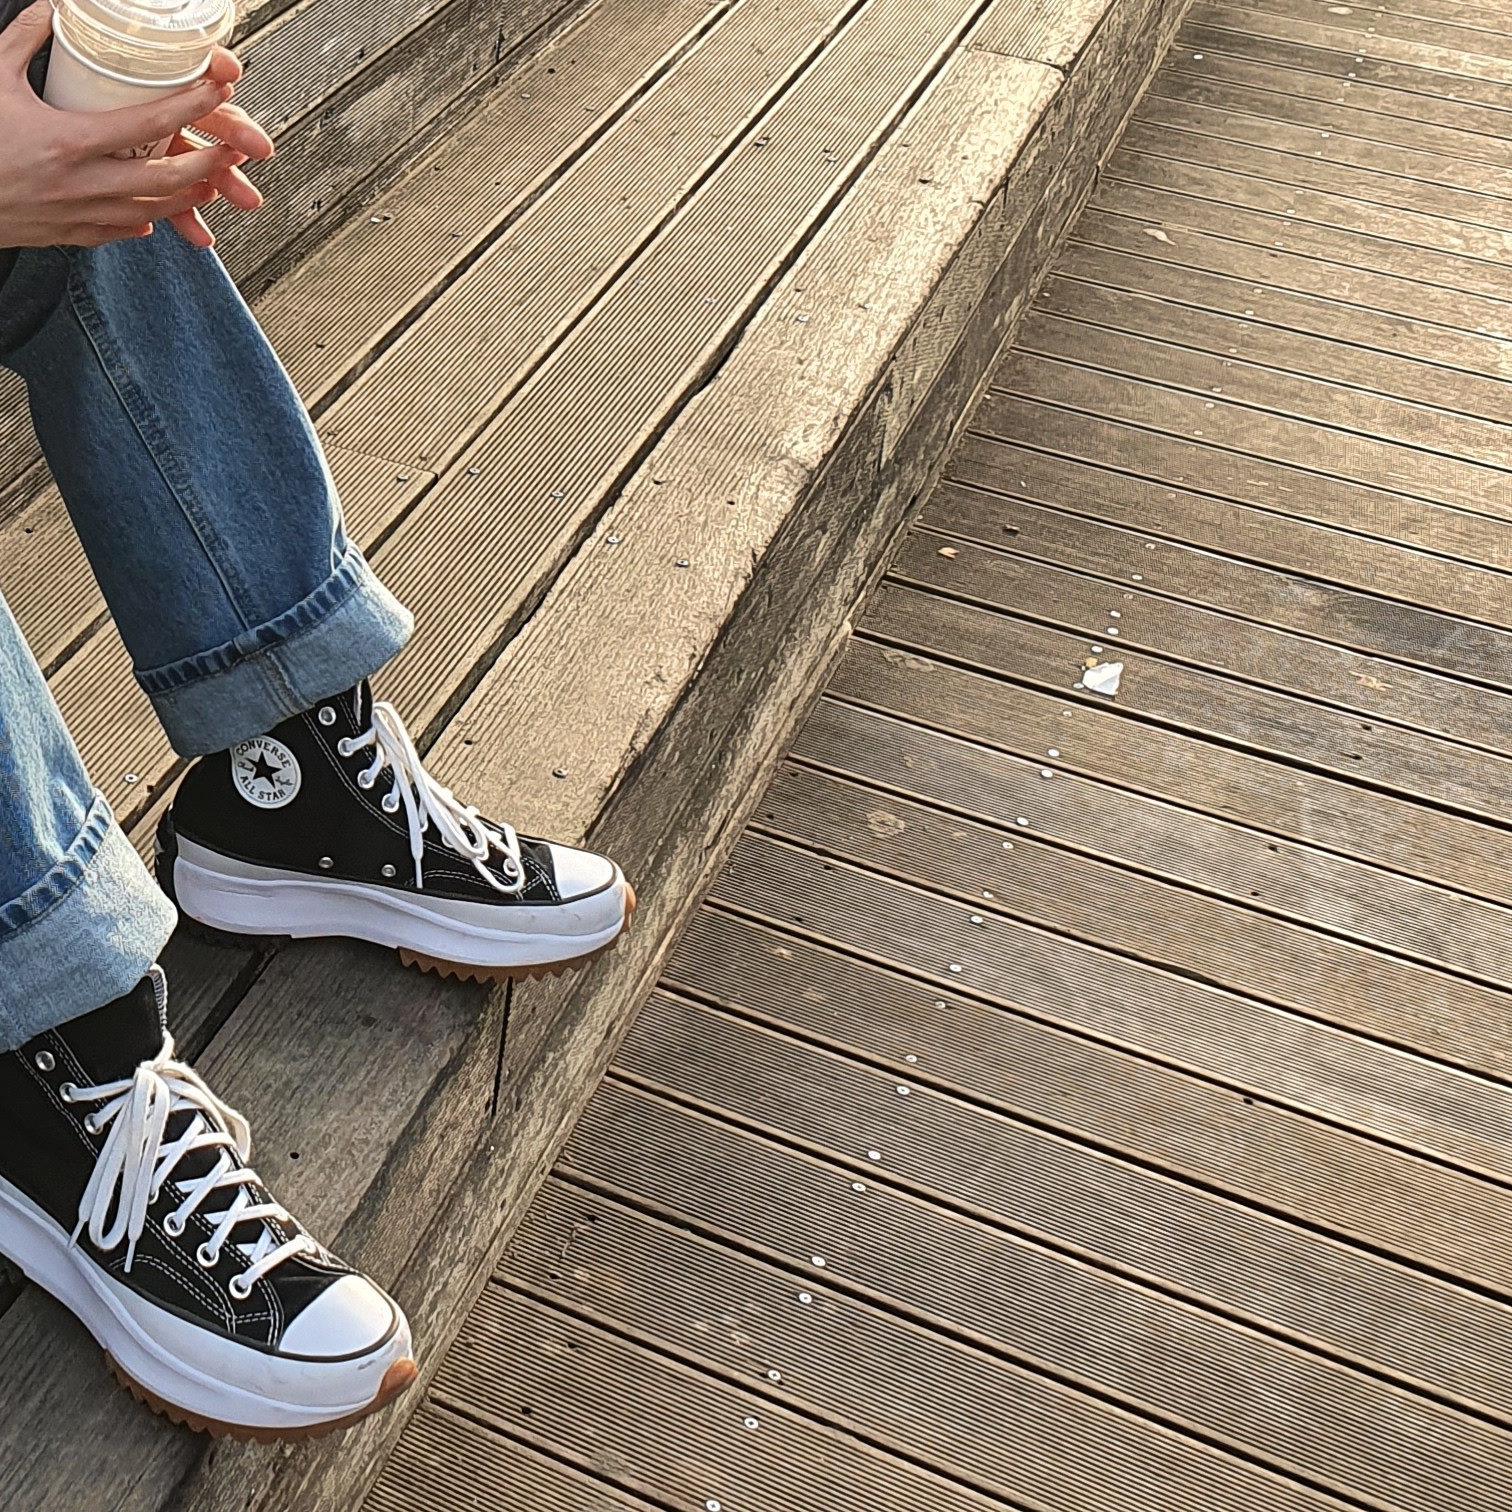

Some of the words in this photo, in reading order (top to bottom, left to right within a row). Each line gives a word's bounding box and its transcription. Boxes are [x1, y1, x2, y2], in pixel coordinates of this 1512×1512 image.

[235, 739, 291, 768] CONVERSE
[240, 774, 256, 795] ALL
[257, 788, 286, 801] STAR
